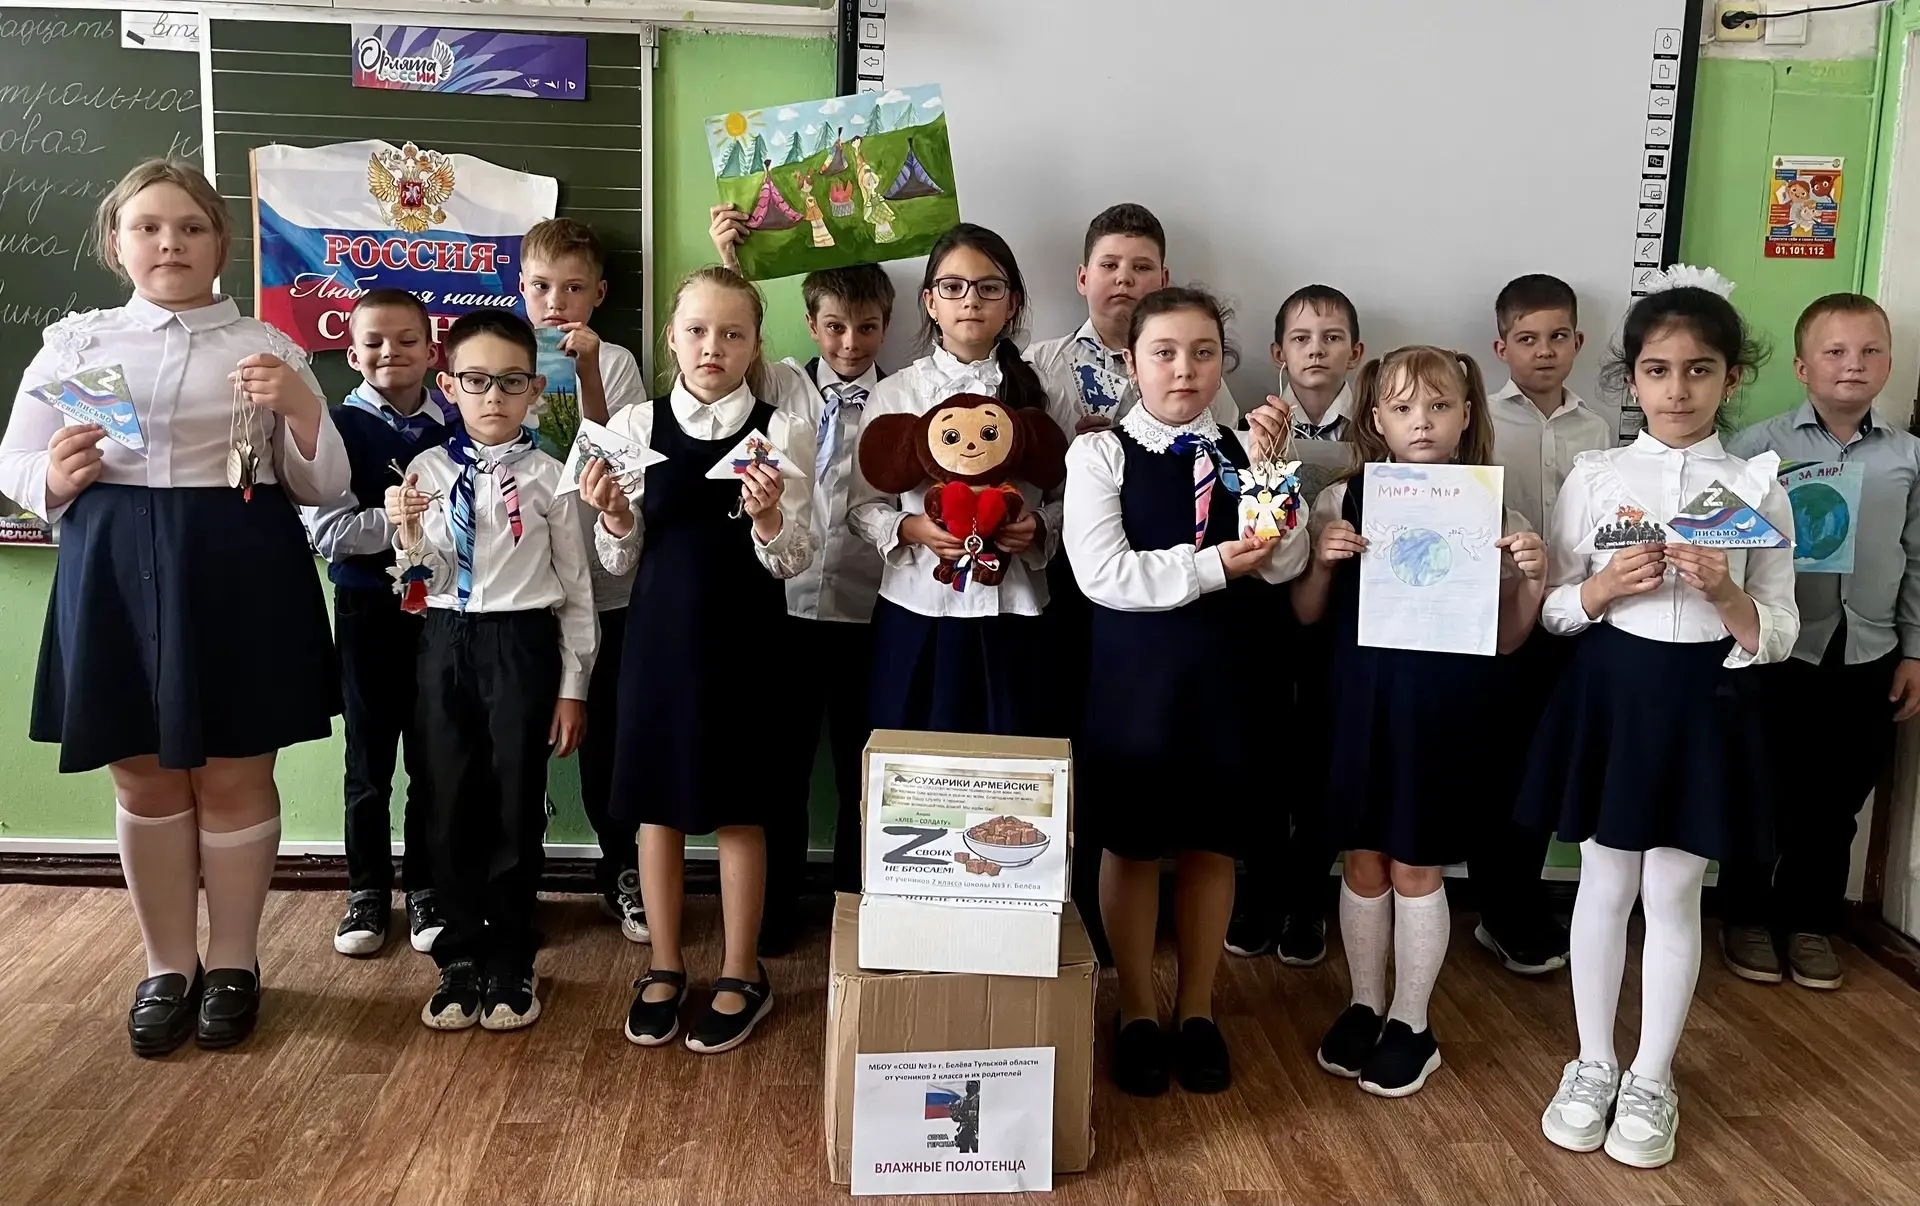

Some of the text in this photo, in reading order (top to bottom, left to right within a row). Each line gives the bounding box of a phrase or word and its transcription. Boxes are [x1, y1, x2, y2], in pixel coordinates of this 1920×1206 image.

[0, 13, 114, 45] адцать
[361, 38, 437, 75] Орлята
[380, 68, 436, 83] РОССИИ
[324, 234, 509, 273] РОССИЯ-
[1808, 246, 1824, 255] 112
[442, 291, 518, 308] наша
[76, 401, 112, 424] ПИСЬМО
[1799, 470, 1812, 480] ЗА
[914, 776, 970, 788] СУХАРИКИ
[973, 780, 1040, 792] АРМЕЙСКИЕ
[895, 876, 930, 884] учеников
[894, 1062, 916, 1070] «СОШ
[974, 1059, 1008, 1068] Тульской
[1010, 1058, 1038, 1066] области
[938, 1072, 962, 1080] класса
[982, 1070, 1022, 1078] родителей
[874, 1159, 1026, 1174] ВЛАЖНЫЕ ПОЛОТЕНЦА
